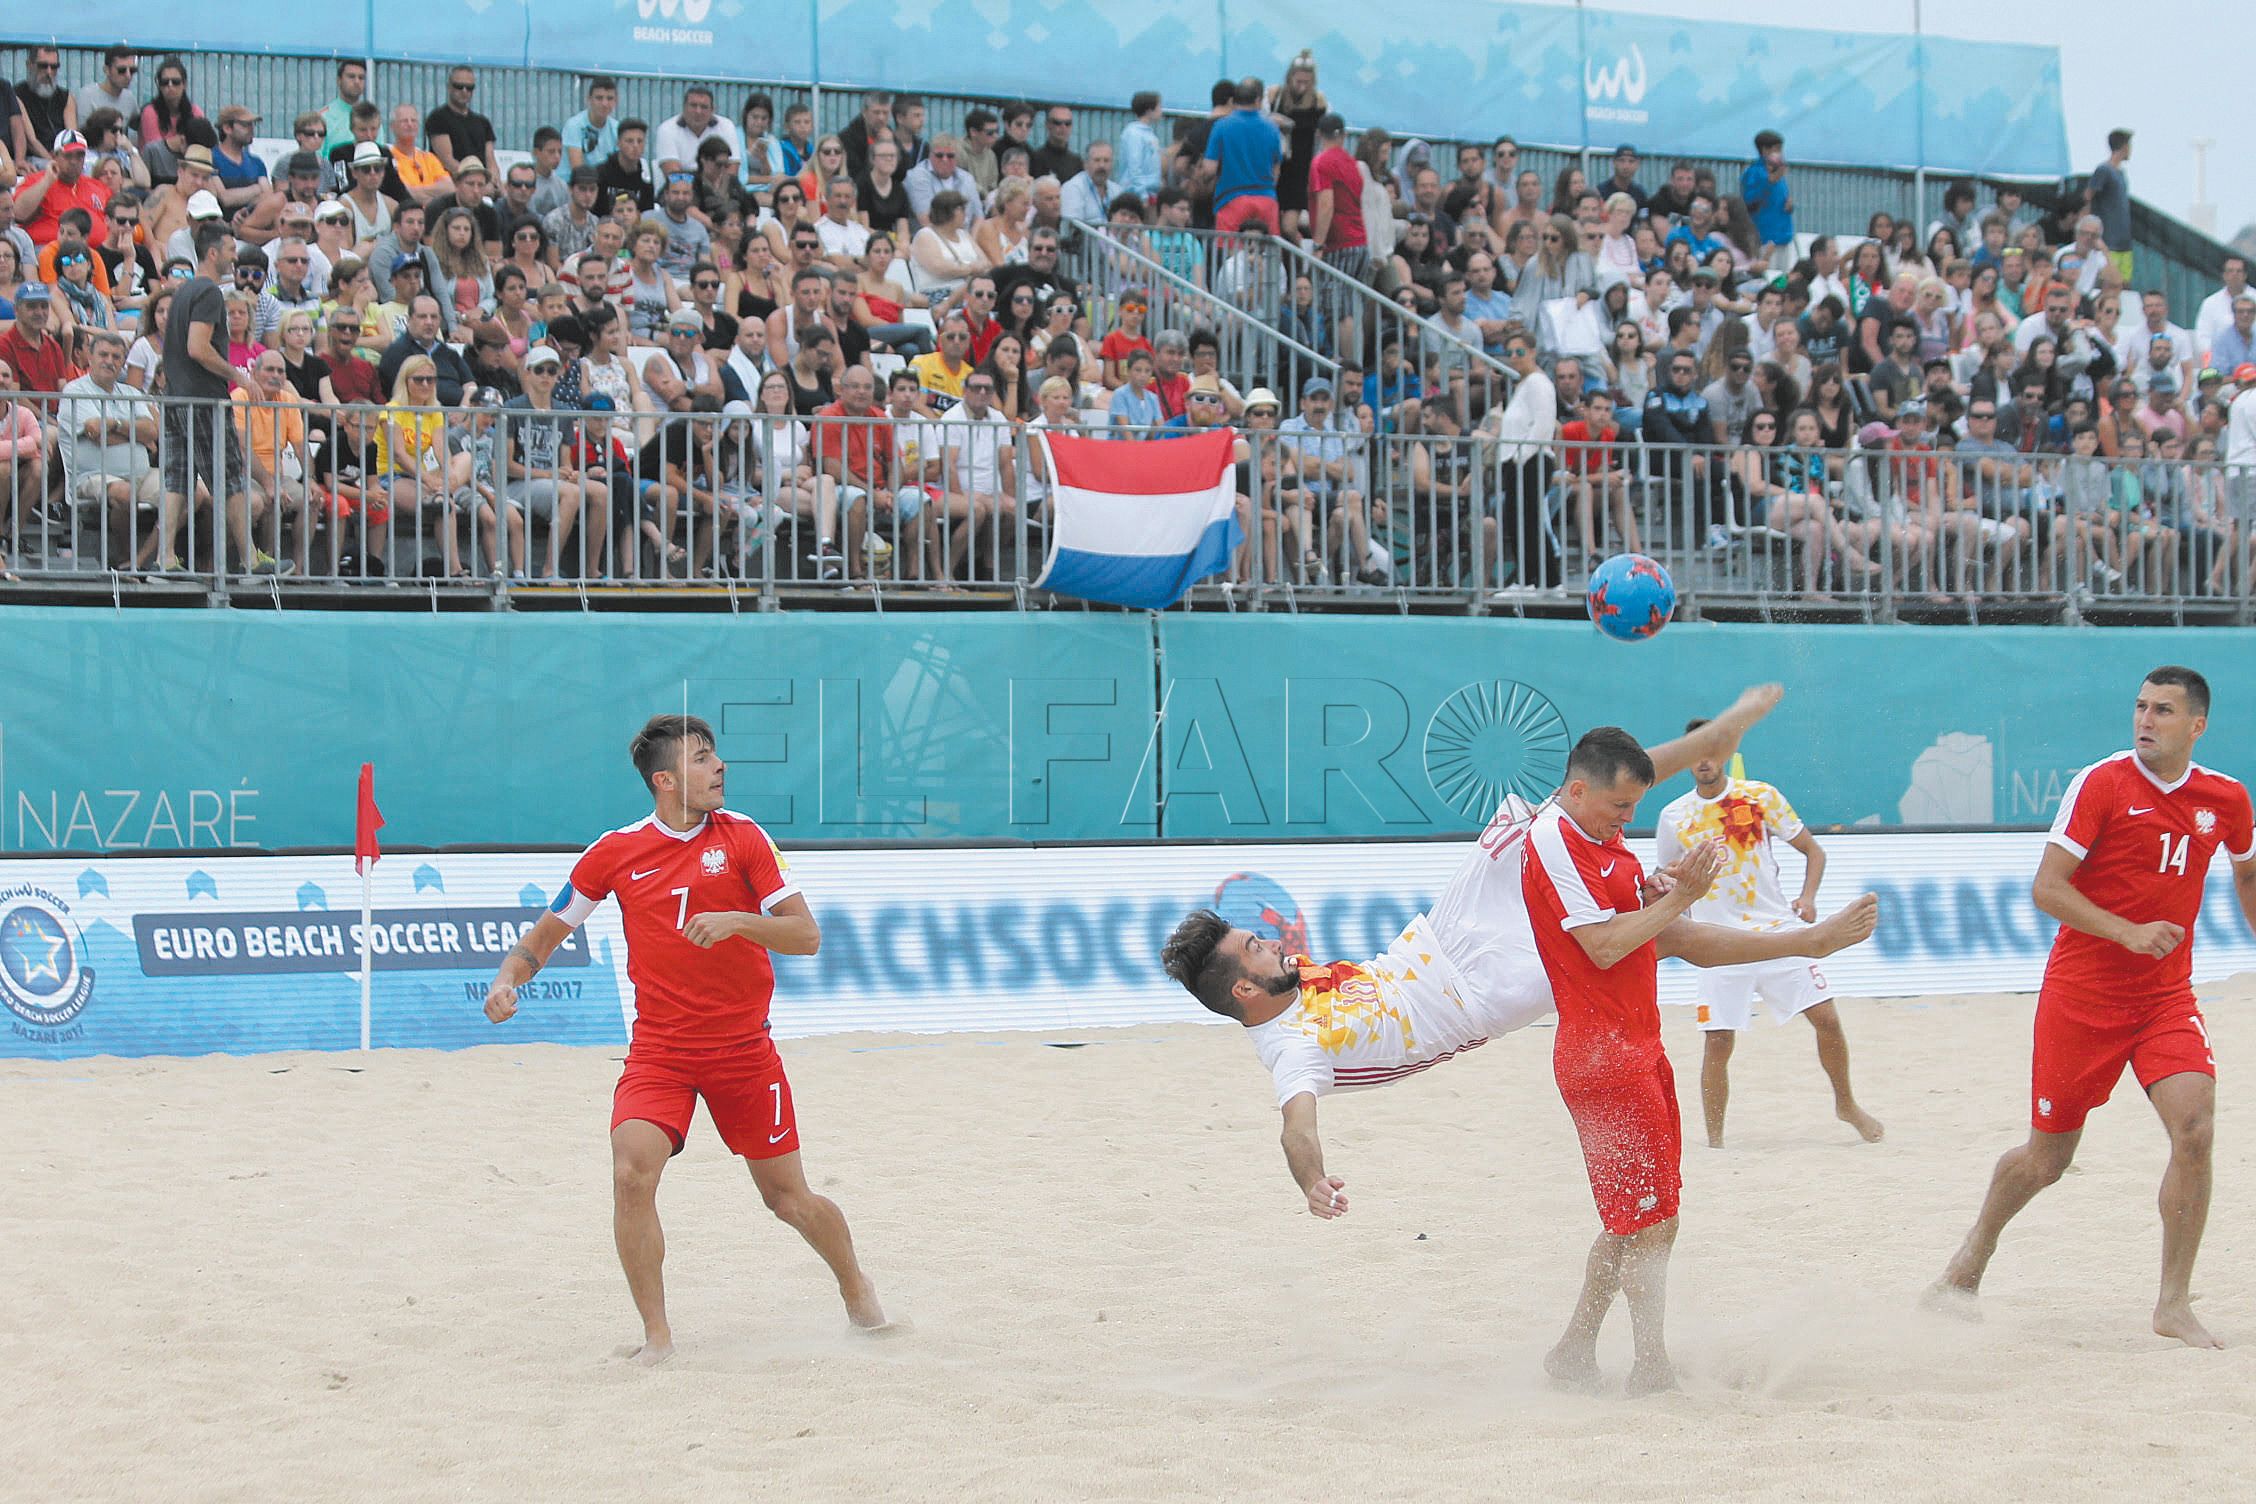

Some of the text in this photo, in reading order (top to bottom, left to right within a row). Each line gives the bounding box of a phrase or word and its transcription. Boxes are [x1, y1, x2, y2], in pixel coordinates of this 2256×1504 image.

[633, 26, 714, 46] BEACH SOCCER
[18, 777, 260, 848] NAZARÉ
[1712, 834, 1729, 864] 5
[2159, 832, 2190, 876] 14
[671, 887, 689, 929] 7
[153, 921, 577, 959] EURO BEACH SOCCER LEAE
[541, 981, 583, 1000] 2017
[1808, 964, 1828, 990] 5
